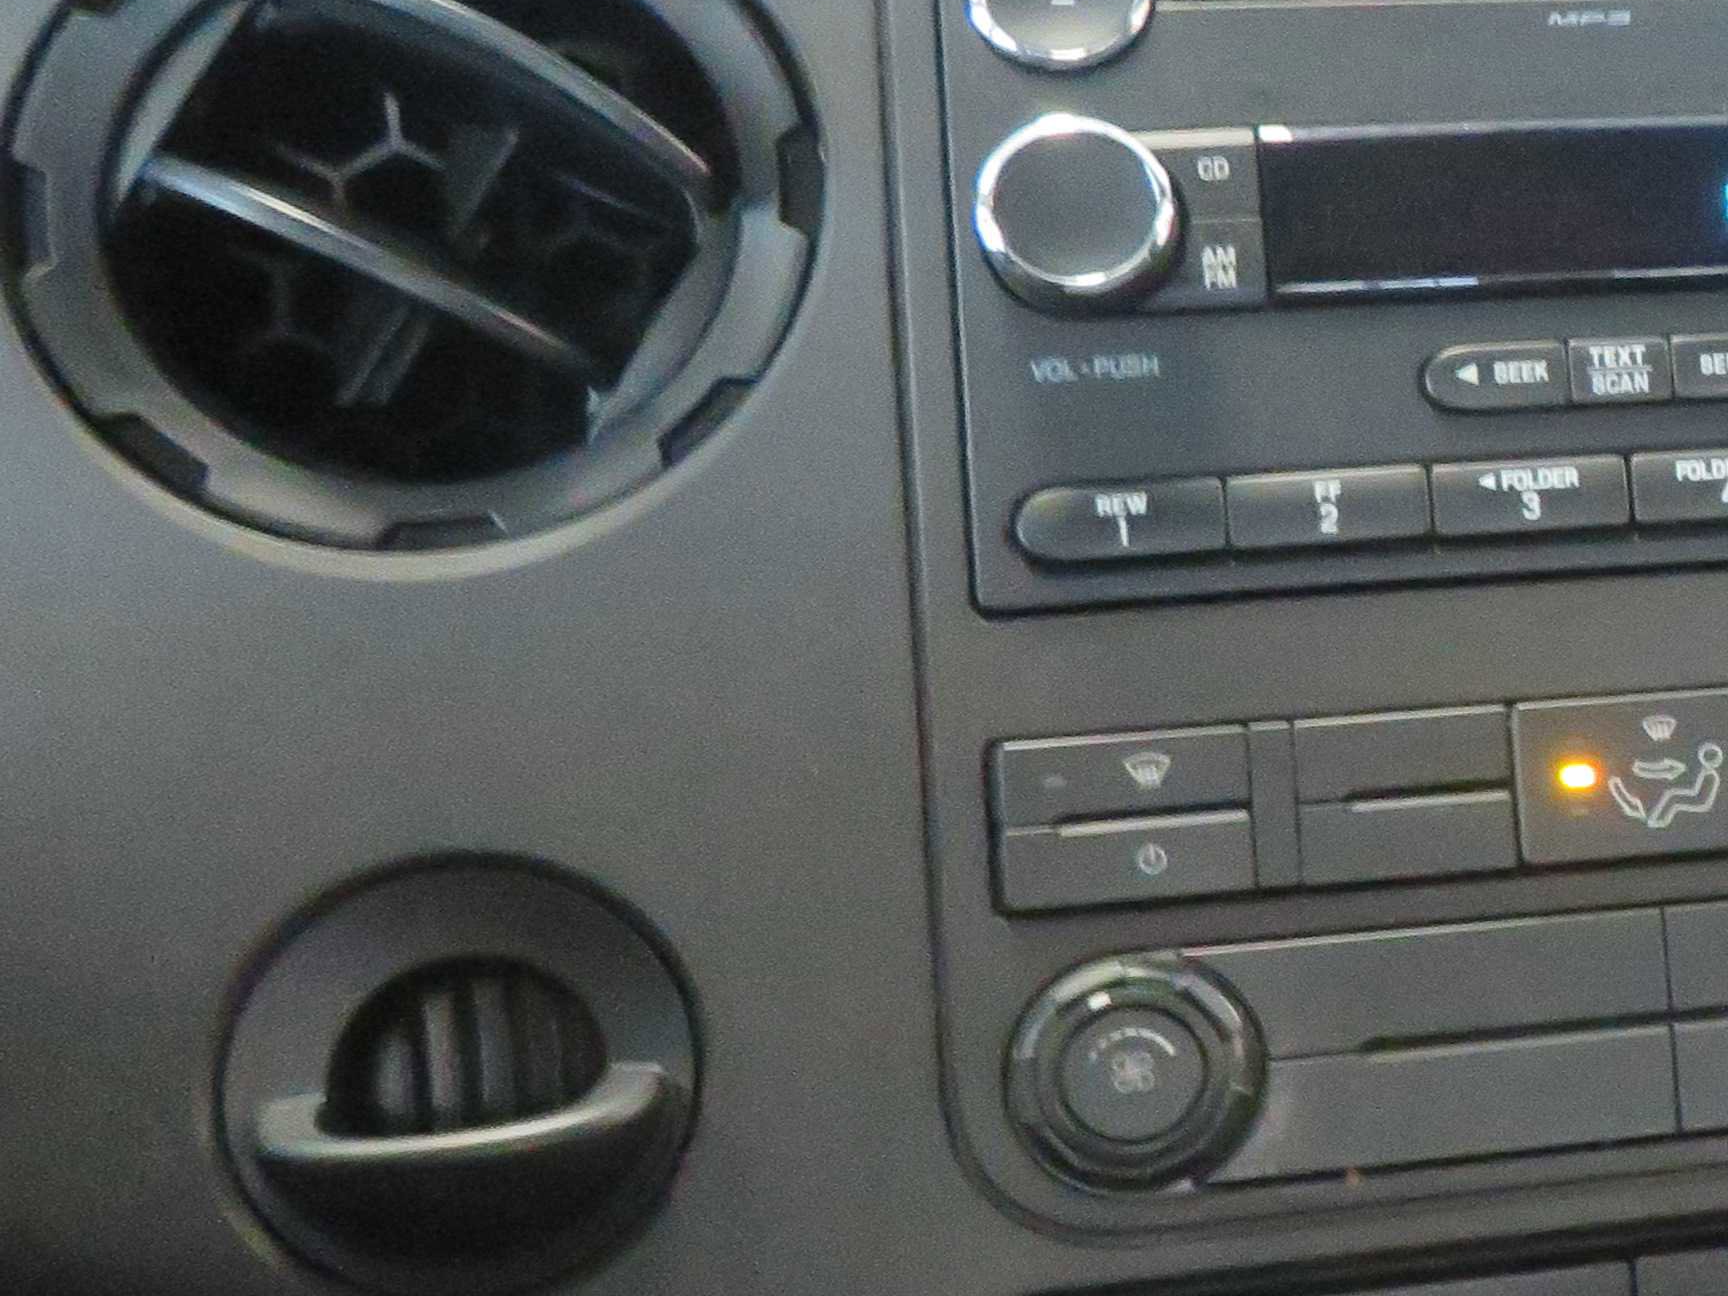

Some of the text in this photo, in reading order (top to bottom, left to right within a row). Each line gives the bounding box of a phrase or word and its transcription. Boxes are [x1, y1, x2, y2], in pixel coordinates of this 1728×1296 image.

[1198, 156, 1230, 182] CD
[1202, 245, 1236, 267] AM
[1204, 267, 1237, 290] FM
[1590, 345, 1645, 368] TEXT
[1493, 360, 1549, 385] SEEK
[1592, 370, 1650, 396] SCAN
[1314, 480, 1341, 503] FF
[1501, 466, 1580, 493] FOLDER
[1097, 492, 1148, 517] REW
[1521, 491, 1542, 521] 3
[1319, 503, 1340, 535] 2
[1116, 516, 1130, 548] 1
